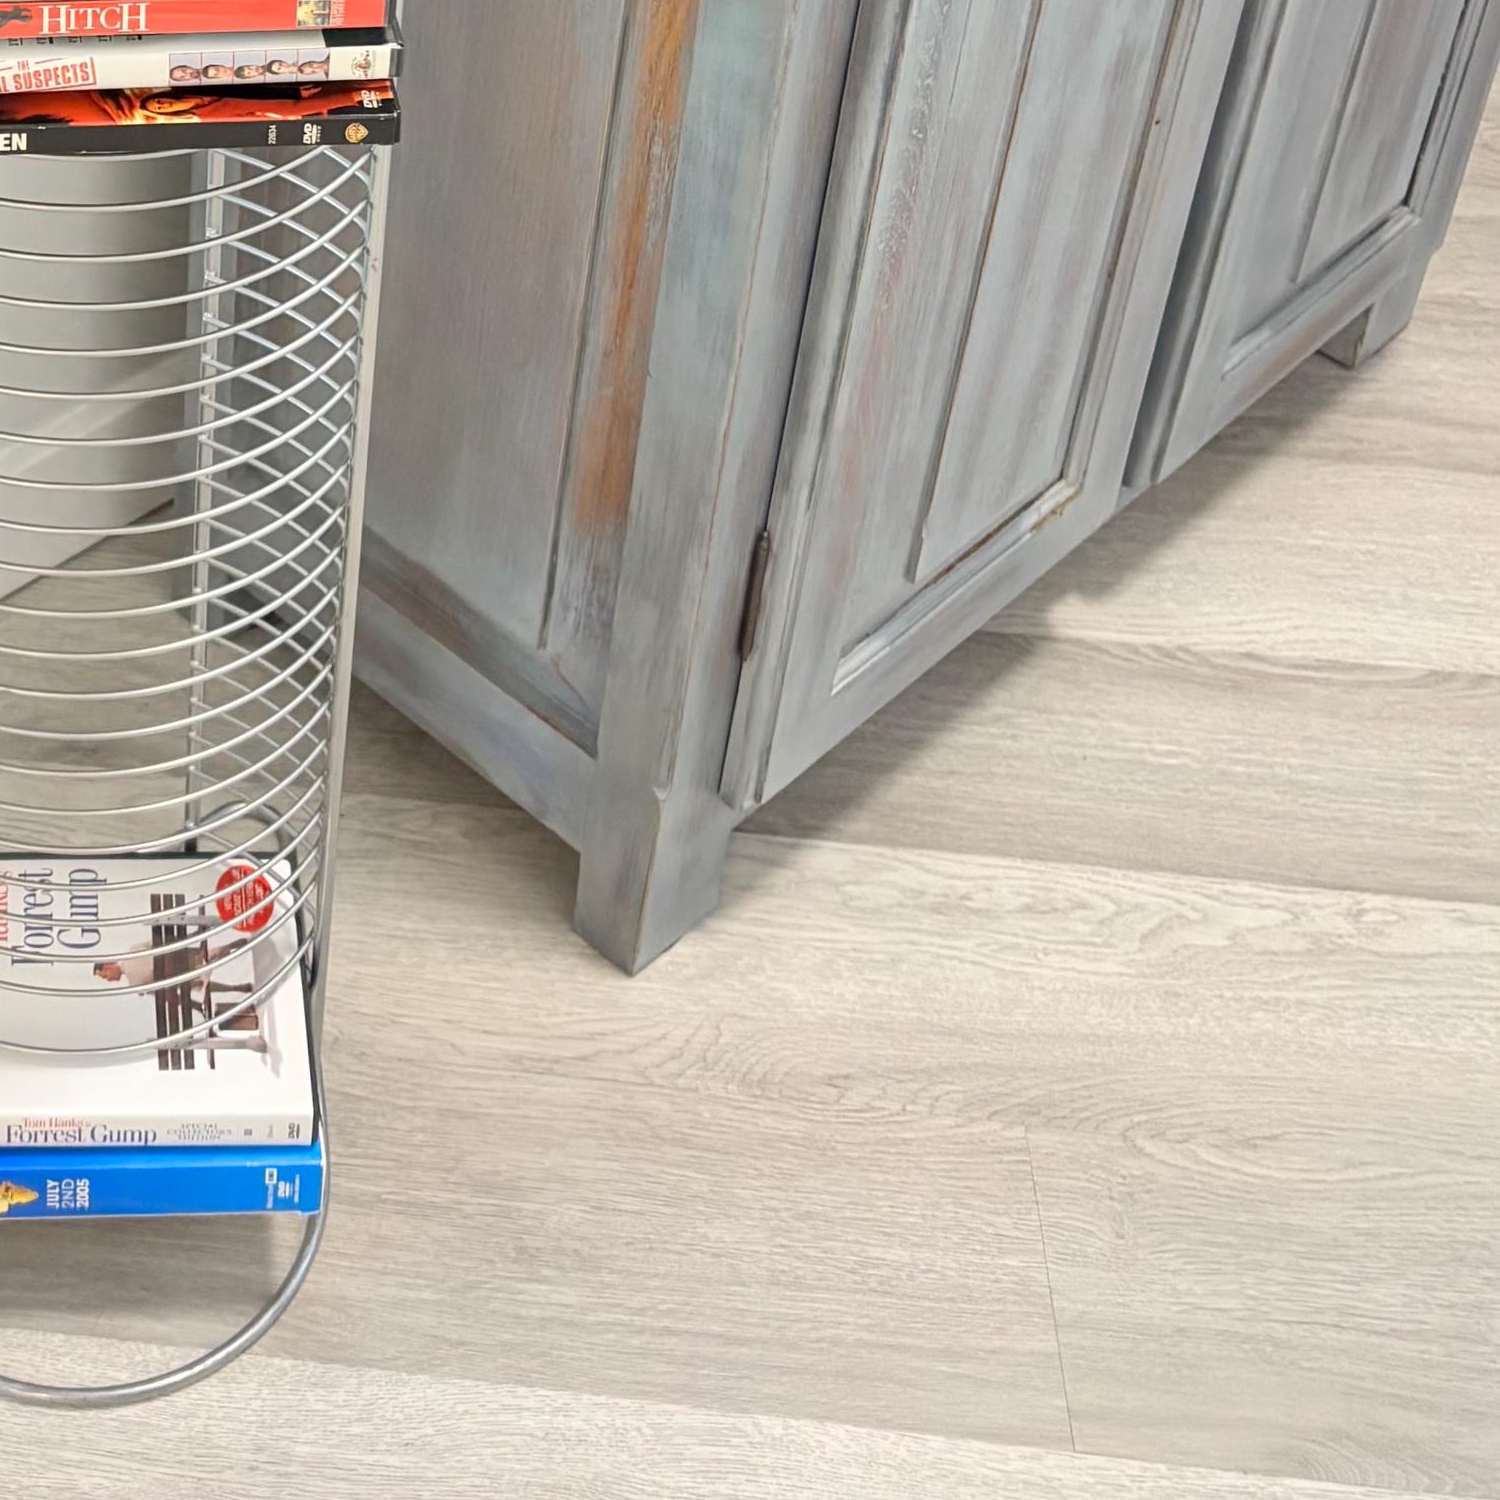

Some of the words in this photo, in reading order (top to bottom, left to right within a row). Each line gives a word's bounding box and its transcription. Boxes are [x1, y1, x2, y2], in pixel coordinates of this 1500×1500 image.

[38, 2, 150, 36] HITCH
[14, 62, 91, 91] SUSPECTS
[17, 61, 30, 70] THE
[303, 123, 313, 144] DVD
[11, 866, 55, 966] Forrest
[56, 868, 108, 950] Gump
[6, 1124, 85, 1144] Forrest
[90, 1123, 158, 1146] Gump
[21, 1117, 47, 1128] Tom
[49, 1116, 85, 1128] Hanks
[46, 1179, 60, 1210] JULY
[60, 1178, 75, 1209] 2ND
[76, 1178, 91, 1210] 2005
